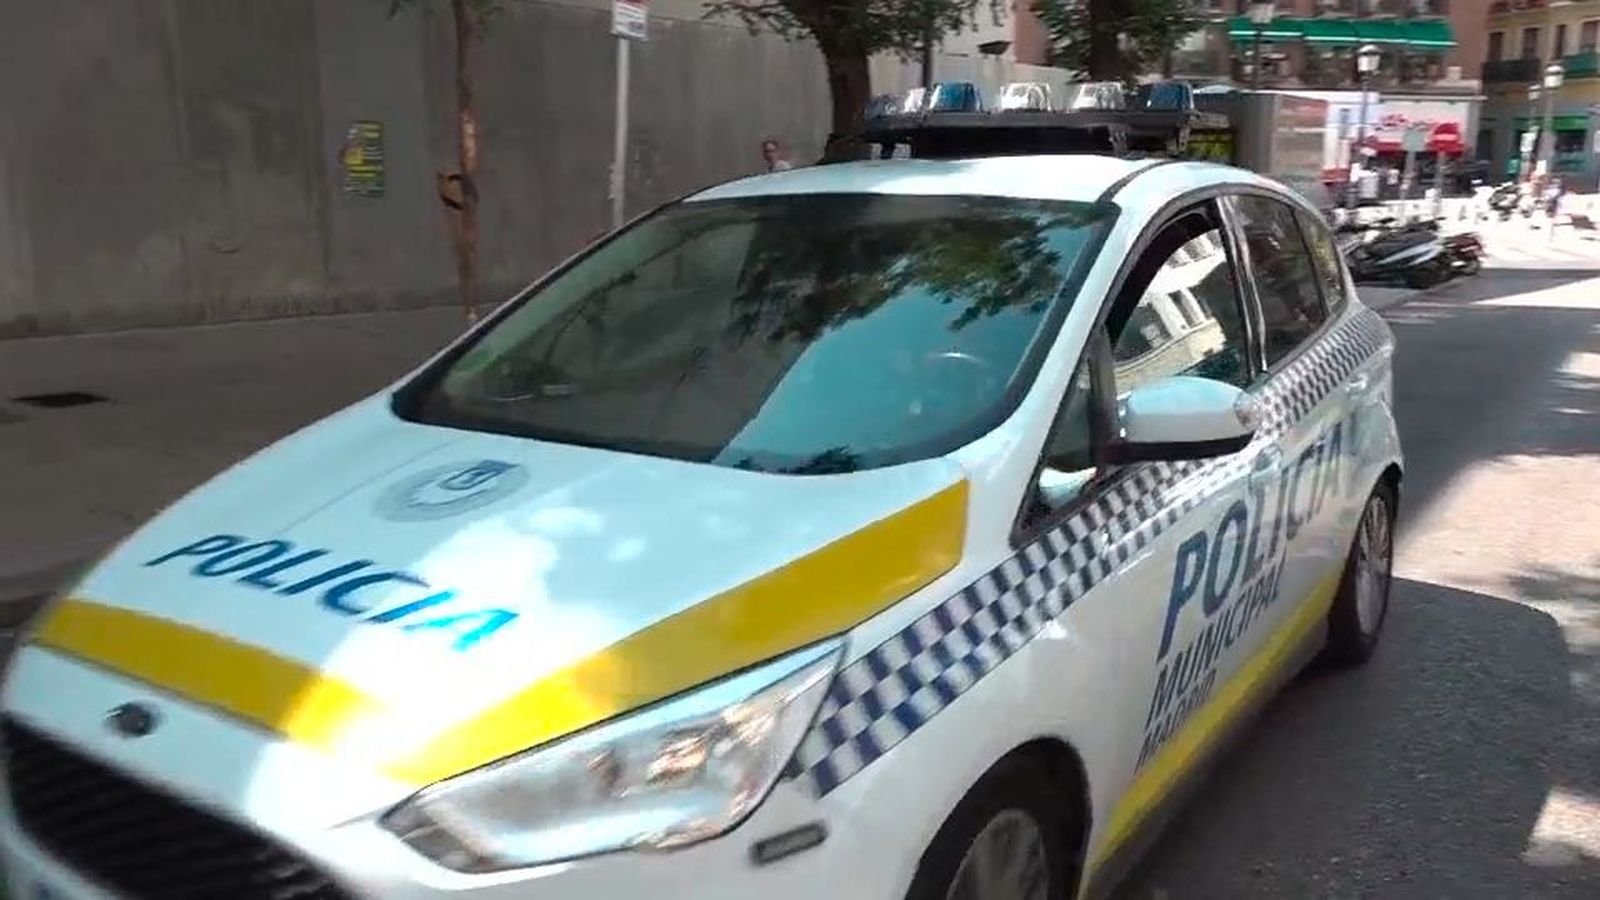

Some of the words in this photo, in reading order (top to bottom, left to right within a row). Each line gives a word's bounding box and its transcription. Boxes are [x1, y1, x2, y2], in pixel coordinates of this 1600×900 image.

[143, 534, 520, 650] POLICIA
[1155, 421, 1343, 663] POLICIA
[1144, 549, 1286, 733] MUNICIPAL
